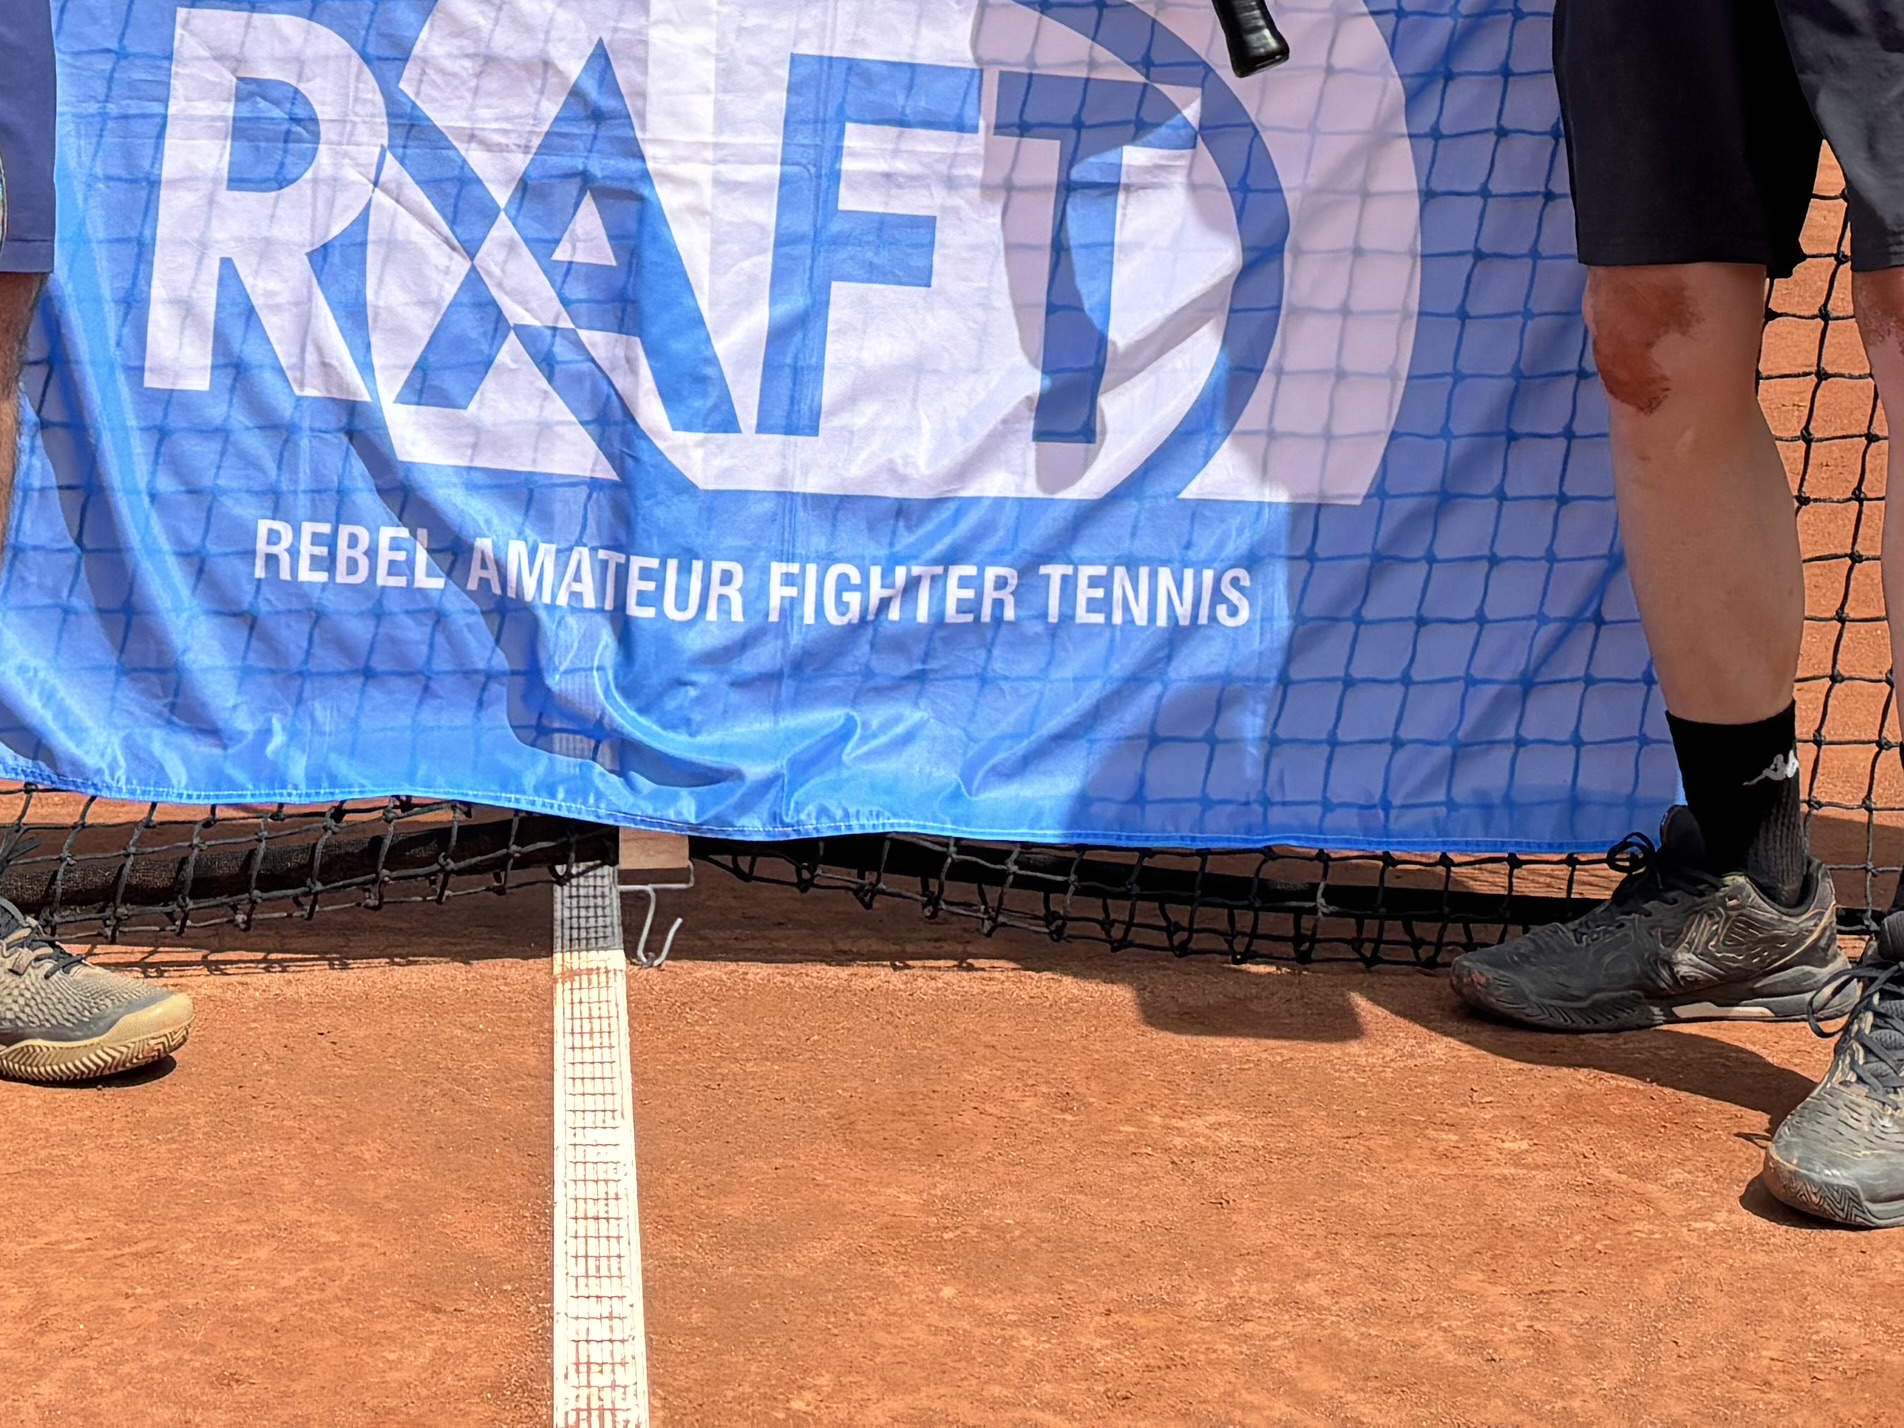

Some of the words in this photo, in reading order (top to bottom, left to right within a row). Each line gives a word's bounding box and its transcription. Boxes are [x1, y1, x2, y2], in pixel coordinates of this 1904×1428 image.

[143, 7, 1202, 446] RAFT
[252, 518, 446, 590] REBEL
[465, 535, 745, 624] AMATEUR
[767, 560, 1018, 625] FIGHTER
[1037, 564, 1252, 628] TENNIS
